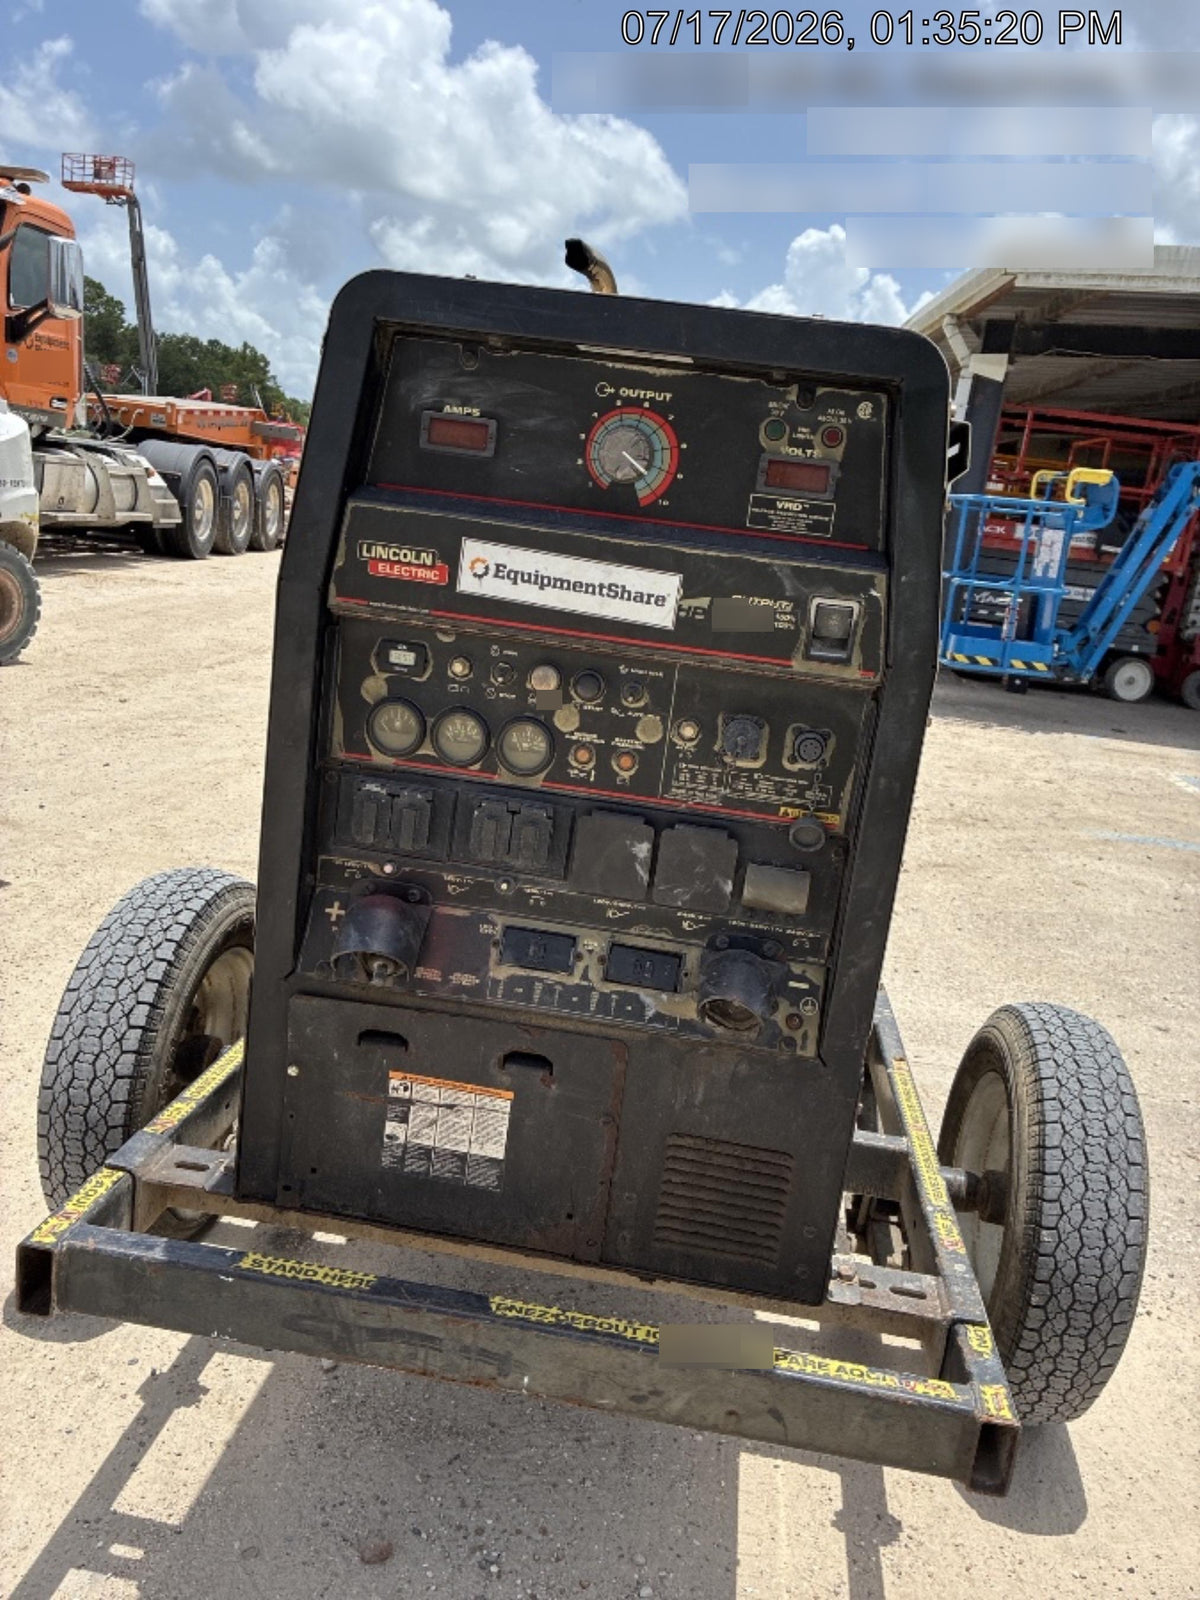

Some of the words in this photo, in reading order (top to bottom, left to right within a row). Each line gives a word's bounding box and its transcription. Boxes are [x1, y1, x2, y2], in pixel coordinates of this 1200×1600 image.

[619, 387, 673, 402] OUTPUT
[443, 404, 481, 417] AMPS
[781, 446, 822, 459] VOLTS
[362, 543, 433, 565] LINCOLN
[377, 562, 440, 580] ELECTRIC
[492, 563, 667, 607] EquipmentShare
[249, 1258, 319, 1279] STAND
[774, 1352, 829, 1372] PARE
